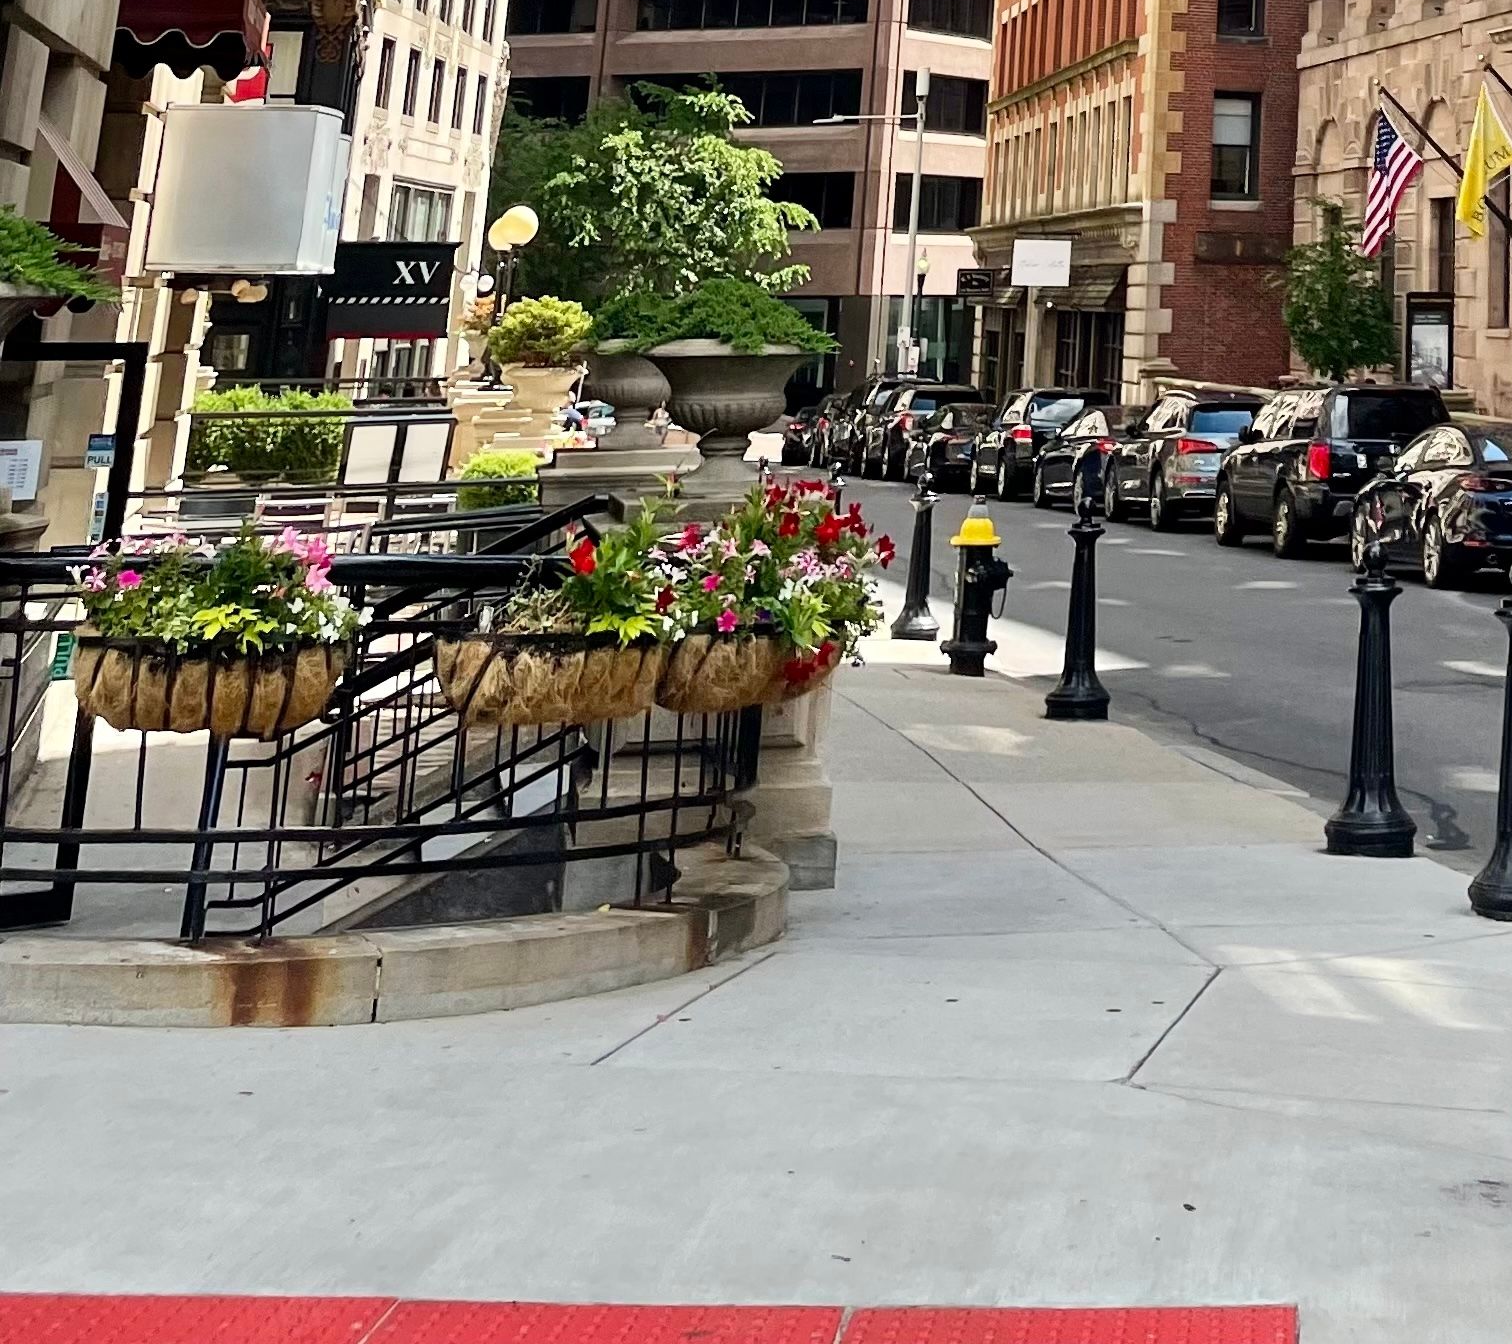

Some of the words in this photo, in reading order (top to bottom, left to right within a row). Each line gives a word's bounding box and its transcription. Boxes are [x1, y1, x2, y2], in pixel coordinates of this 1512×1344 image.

[392, 261, 441, 285] XV
[87, 455, 113, 465] PULL
[53, 635, 73, 678] PULL
